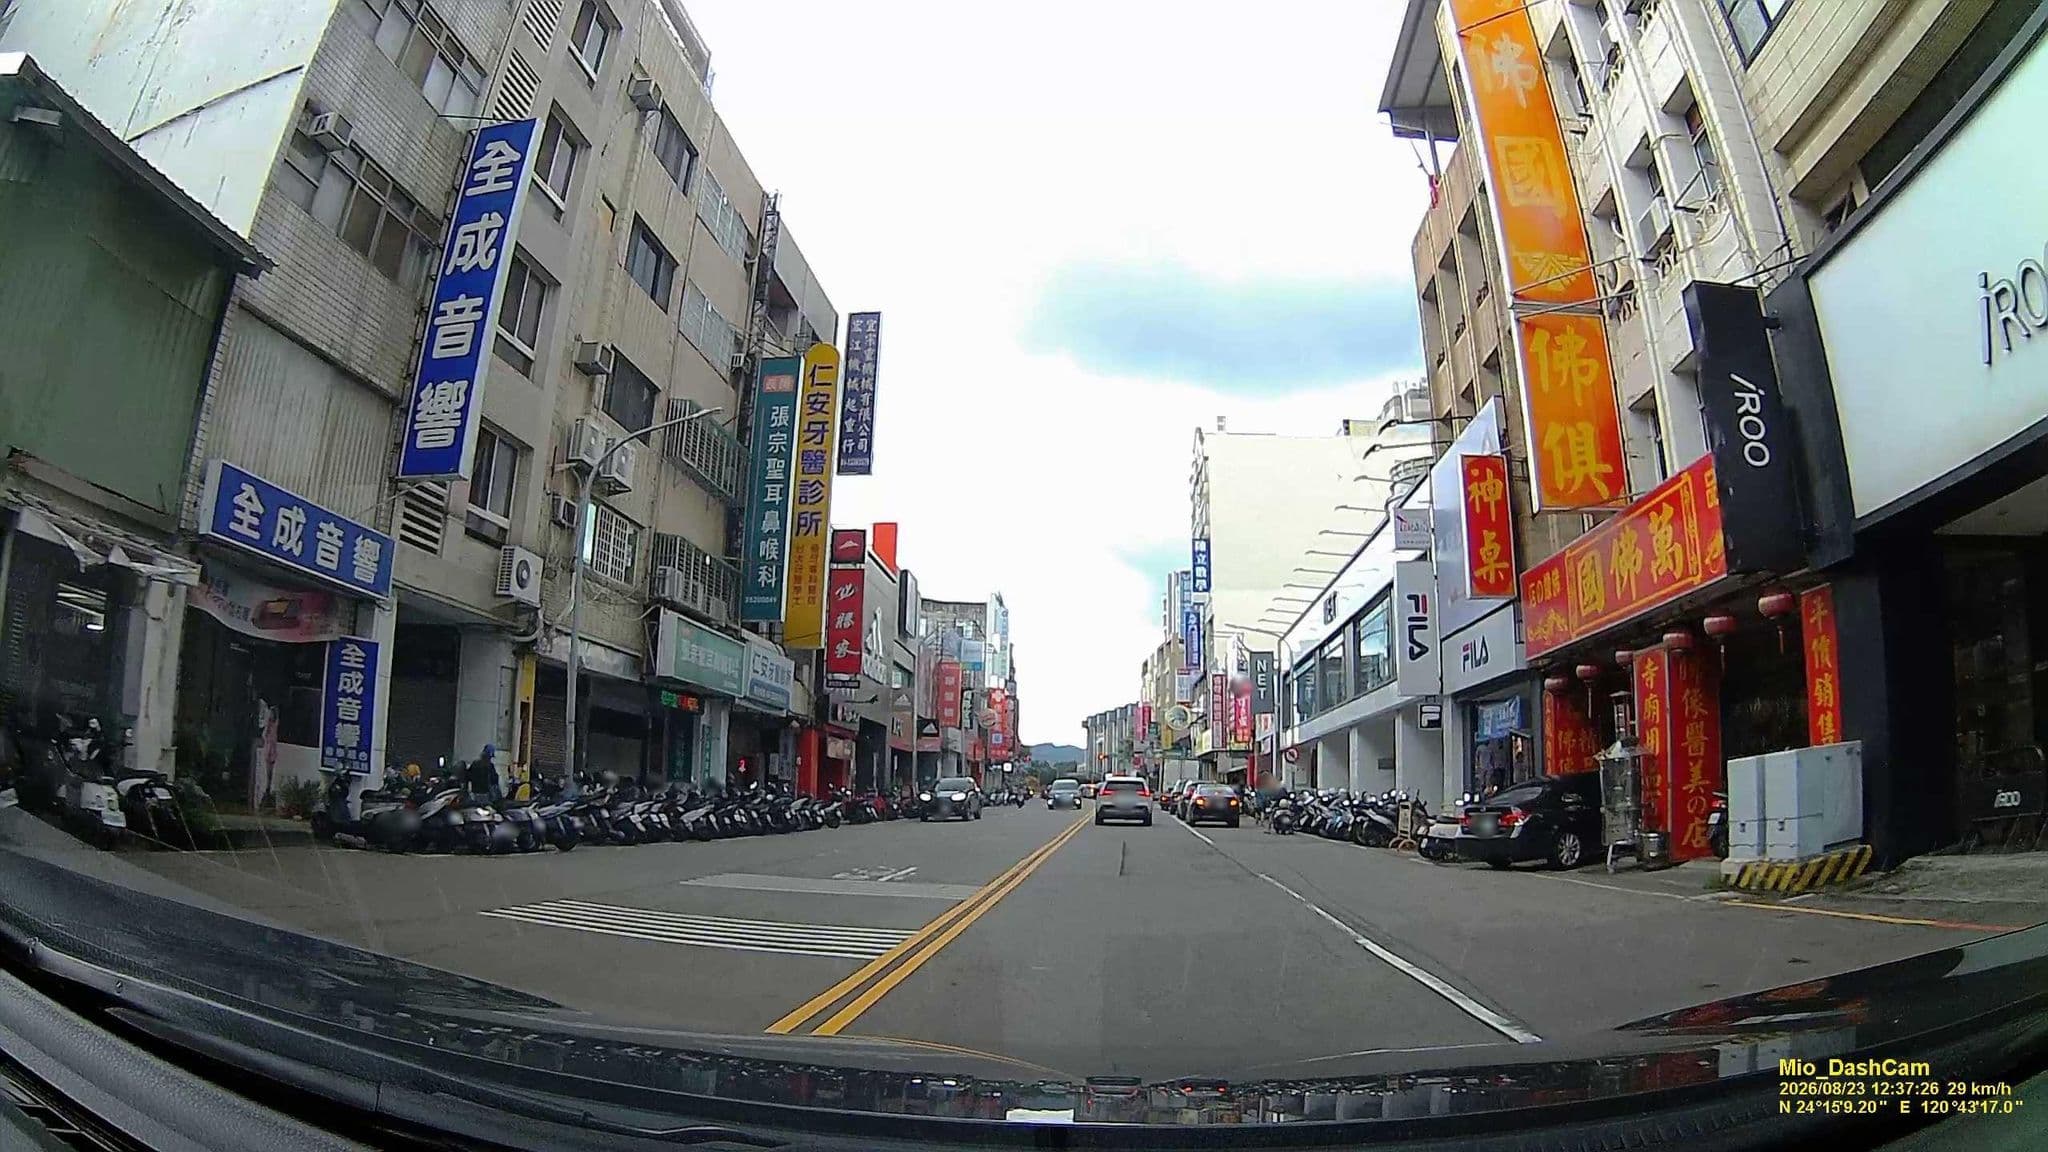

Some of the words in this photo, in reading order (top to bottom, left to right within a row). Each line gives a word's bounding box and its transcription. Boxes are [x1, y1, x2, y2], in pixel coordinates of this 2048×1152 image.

[414, 140, 522, 449] 全成音響
[1978, 241, 2047, 366] iRO
[795, 363, 834, 538] 仁安牙醫診所
[1529, 325, 1614, 500] 佛俱
[229, 482, 381, 585] 全成音響
[757, 405, 790, 589] 張宗聖耳鼻喉科
[1468, 466, 1511, 584] 神桌
[1256, 659, 1268, 700] NET
[1407, 594, 1429, 661] FILA
[1462, 635, 1489, 673] FILA
[334, 643, 367, 748] 全成音響
